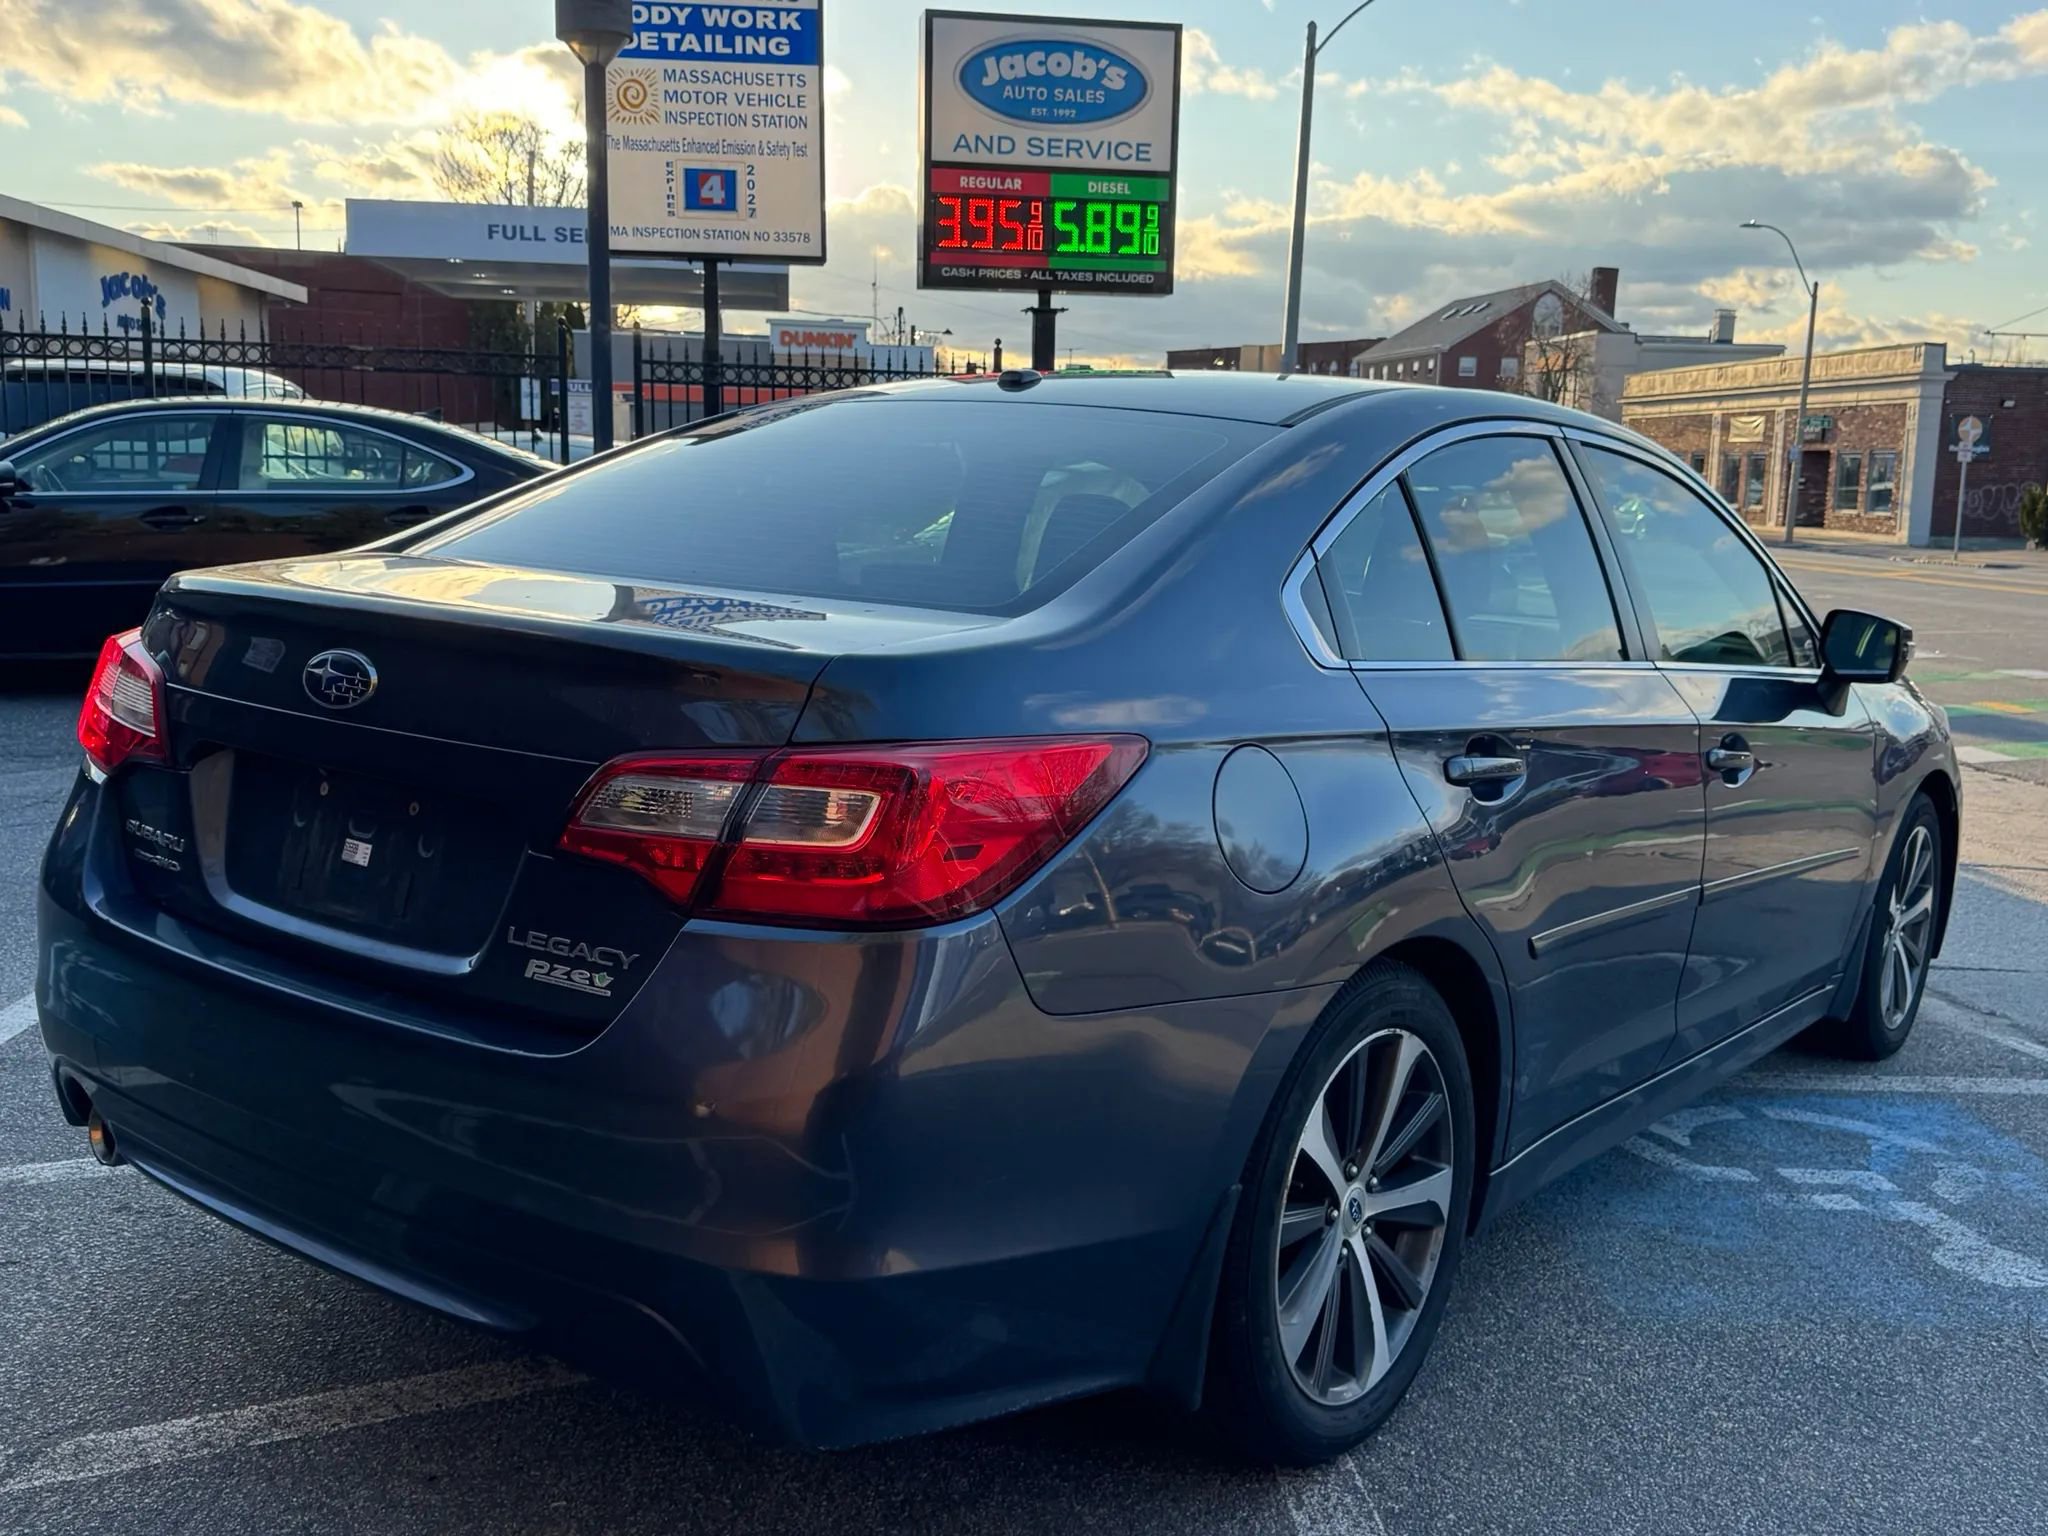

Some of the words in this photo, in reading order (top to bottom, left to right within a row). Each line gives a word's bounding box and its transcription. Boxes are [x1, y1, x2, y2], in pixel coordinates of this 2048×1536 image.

[632, 5, 693, 26] ODY
[702, 7, 801, 31] WORK
[663, 68, 807, 89] MASSACHUSETTS
[981, 50, 1128, 91] Jacob's
[663, 90, 728, 106] MOTOR
[734, 93, 807, 109] VEHICLE
[1003, 84, 1048, 100] AUTO
[1053, 88, 1105, 104] SALES
[664, 110, 748, 128] INSPECTION
[751, 113, 808, 129] STATION
[1053, 108, 1076, 118] 1992
[622, 136, 681, 153] Massachusetts
[682, 137, 720, 155] Enhanced
[722, 138, 757, 156] Emission
[758, 140, 766, 156] &
[767, 139, 791, 160] Safety
[792, 141, 808, 158] Test
[952, 133, 1016, 155] AND
[1026, 136, 1152, 163] SERVICE
[665, 160, 676, 217] EXPIRES
[700, 174, 726, 205] 4
[746, 164, 757, 219] 2027
[960, 175, 1022, 191] REGULAR
[1088, 181, 1131, 195] DIESEL
[488, 224, 546, 242] FULL
[610, 226, 628, 237] MA
[632, 226, 700, 239] INSPECTION
[703, 229, 750, 241] STATION
[753, 230, 770, 242] NO
[773, 231, 811, 244] 33578
[941, 267, 976, 279] CASH
[978, 268, 1022, 280] PRICES
[1030, 270, 1053, 281] ALL
[1055, 271, 1093, 282] TAXES
[1095, 272, 1155, 284] INCLUDED
[568, 382, 592, 393] ULL
[126, 818, 184, 853] SUBARU
[508, 926, 640, 970] LEGACY
